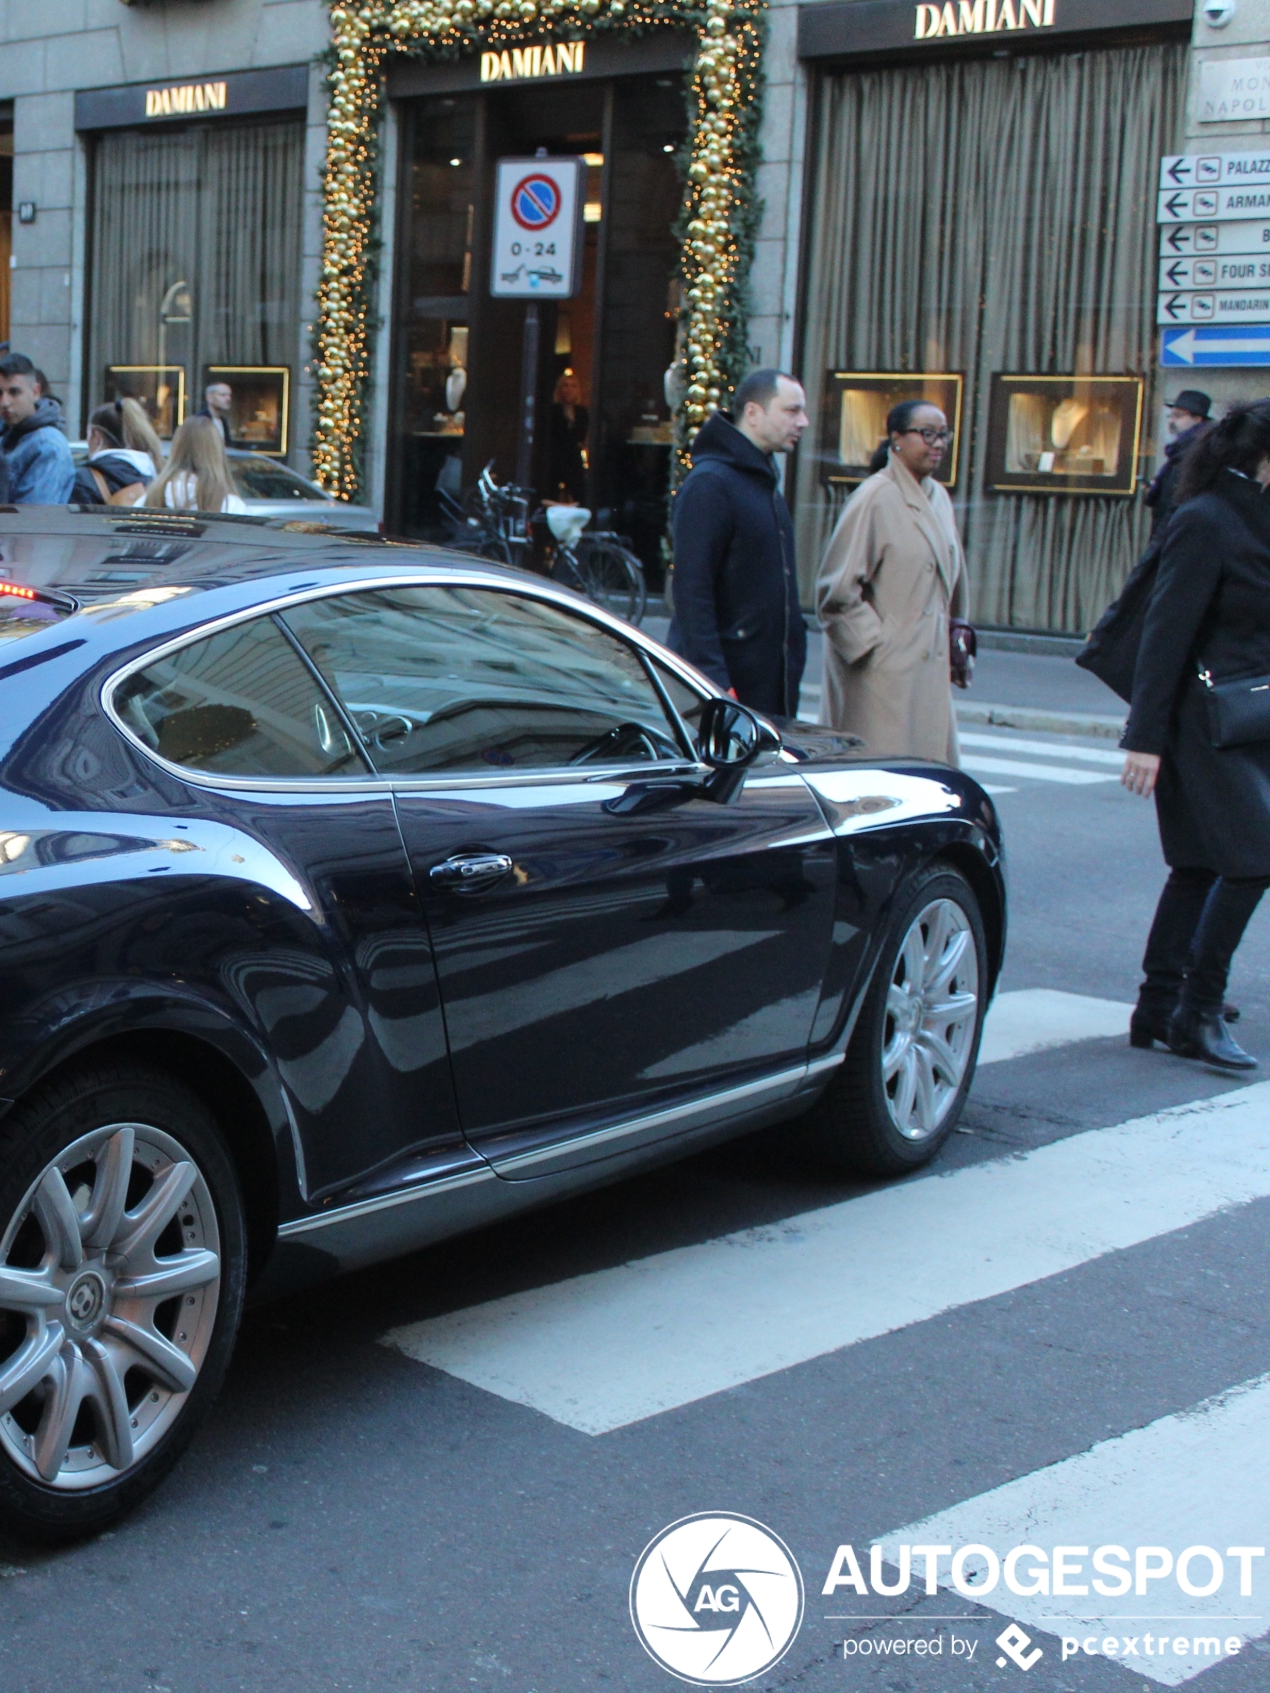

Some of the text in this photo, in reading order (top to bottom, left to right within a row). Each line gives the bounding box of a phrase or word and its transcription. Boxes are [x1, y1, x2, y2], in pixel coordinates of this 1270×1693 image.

[914, 0, 1056, 40] DAMIANI
[480, 41, 586, 83] DAMIANI
[145, 81, 227, 118] DAMIANI
[1204, 97, 1268, 115] NAPOL
[511, 242, 522, 257] 0
[534, 242, 556, 257] 24
[1221, 264, 1256, 279] FOUR
[1219, 299, 1269, 312] MANDARIN
